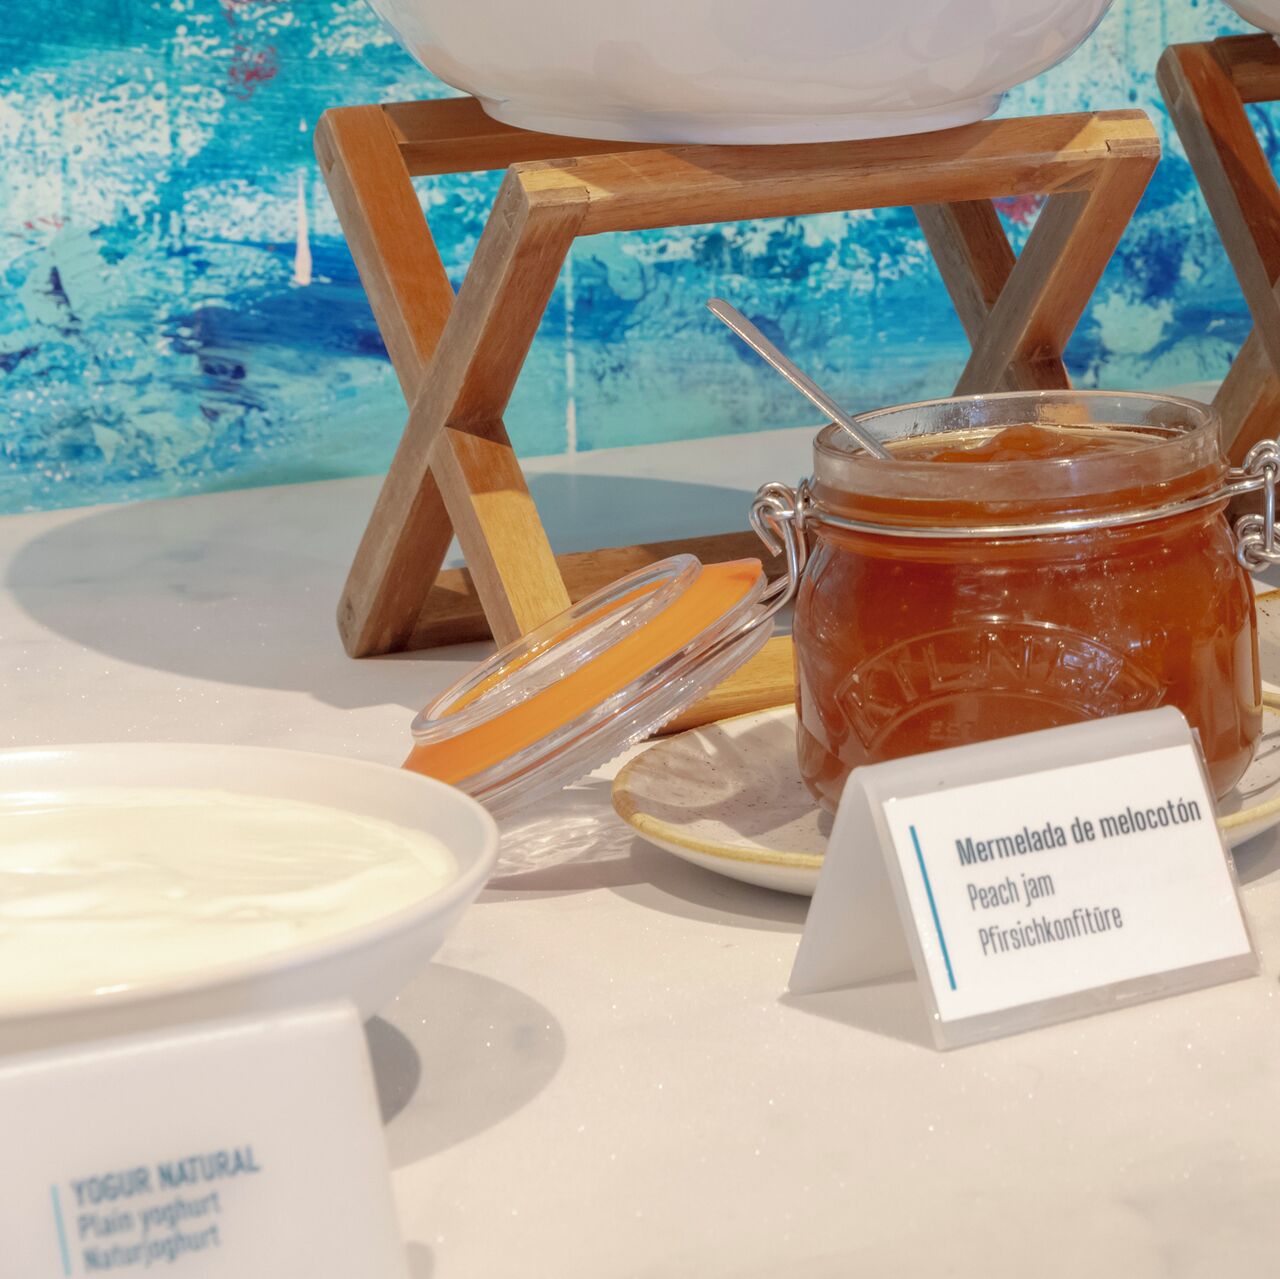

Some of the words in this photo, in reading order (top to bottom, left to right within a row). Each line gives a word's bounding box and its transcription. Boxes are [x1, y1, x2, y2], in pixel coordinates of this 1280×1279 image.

[954, 825, 1067, 867] Mermelada
[1071, 819, 1096, 845] de
[1099, 798, 1202, 840] melocotón
[967, 877, 1020, 911] Peach
[1023, 873, 1056, 908] jam
[978, 905, 1124, 957] Pfirsichkonfitüre
[70, 1166, 153, 1208] YOGUR
[156, 1143, 261, 1191] NATURAL
[77, 1210, 134, 1241] Plain
